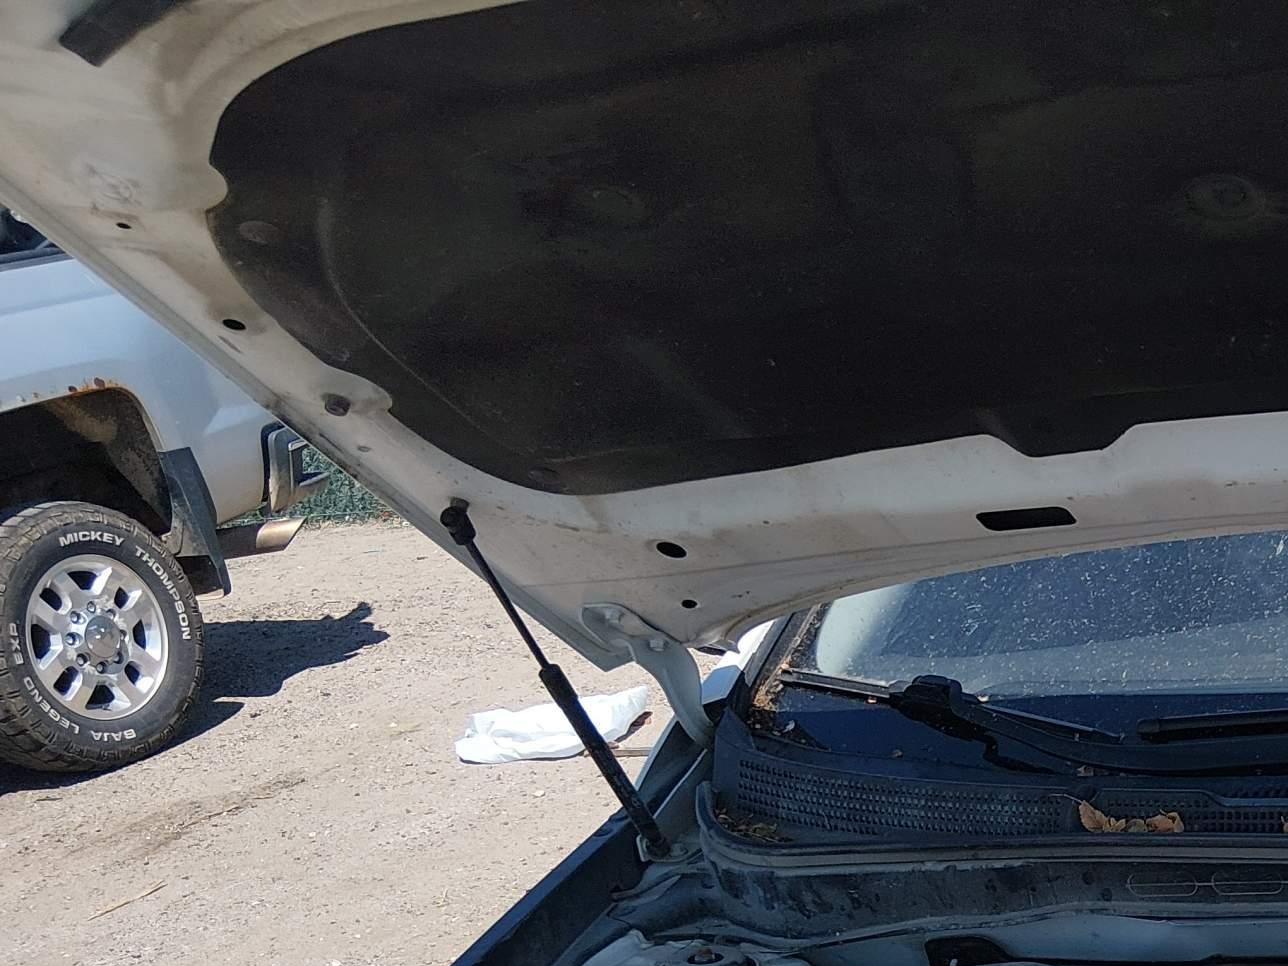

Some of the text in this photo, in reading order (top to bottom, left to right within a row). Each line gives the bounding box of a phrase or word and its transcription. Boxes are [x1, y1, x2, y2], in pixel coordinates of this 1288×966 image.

[58, 530, 192, 641] MICKEY THOMPSON
[8, 622, 137, 743] BAJA LEGEND EXP
